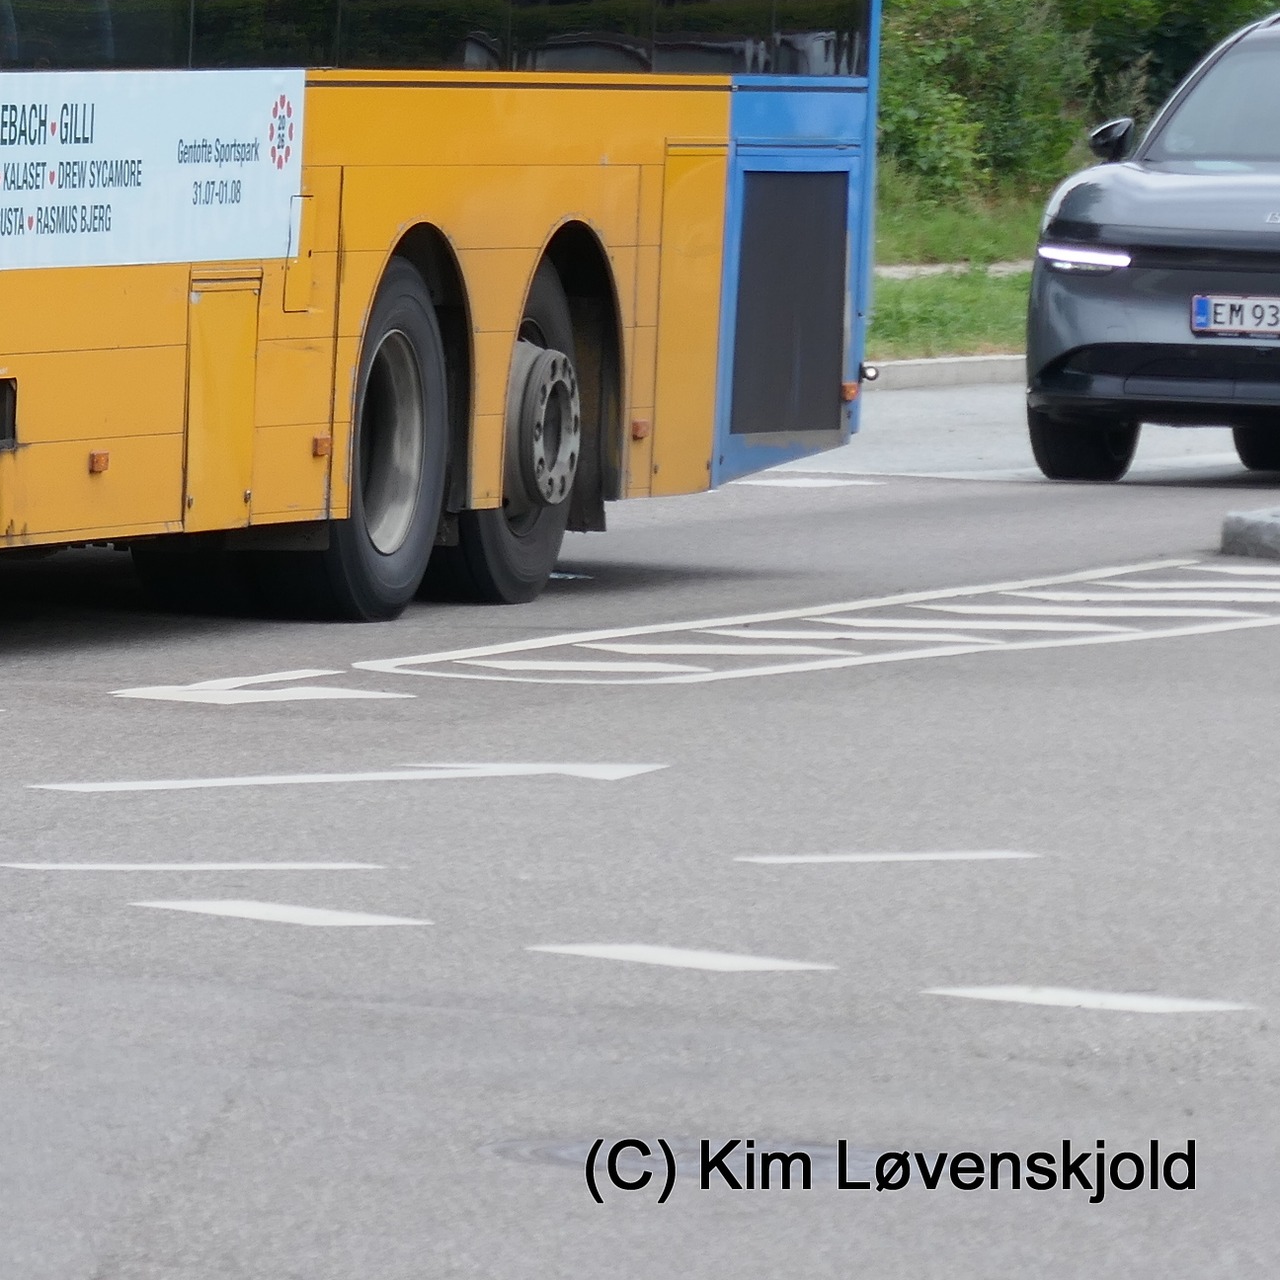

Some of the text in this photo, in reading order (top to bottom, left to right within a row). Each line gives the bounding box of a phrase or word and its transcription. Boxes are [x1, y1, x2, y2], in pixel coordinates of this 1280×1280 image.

[59, 103, 95, 145] GILLI
[177, 137, 260, 168] Gentofte Sportspark
[2, 161, 47, 191] KALASET
[57, 161, 87, 189] DREW
[89, 159, 143, 189] SYCAMORE
[35, 205, 78, 235] RASMUS
[79, 204, 112, 233] BJERG
[1213, 302, 1244, 326] EM
